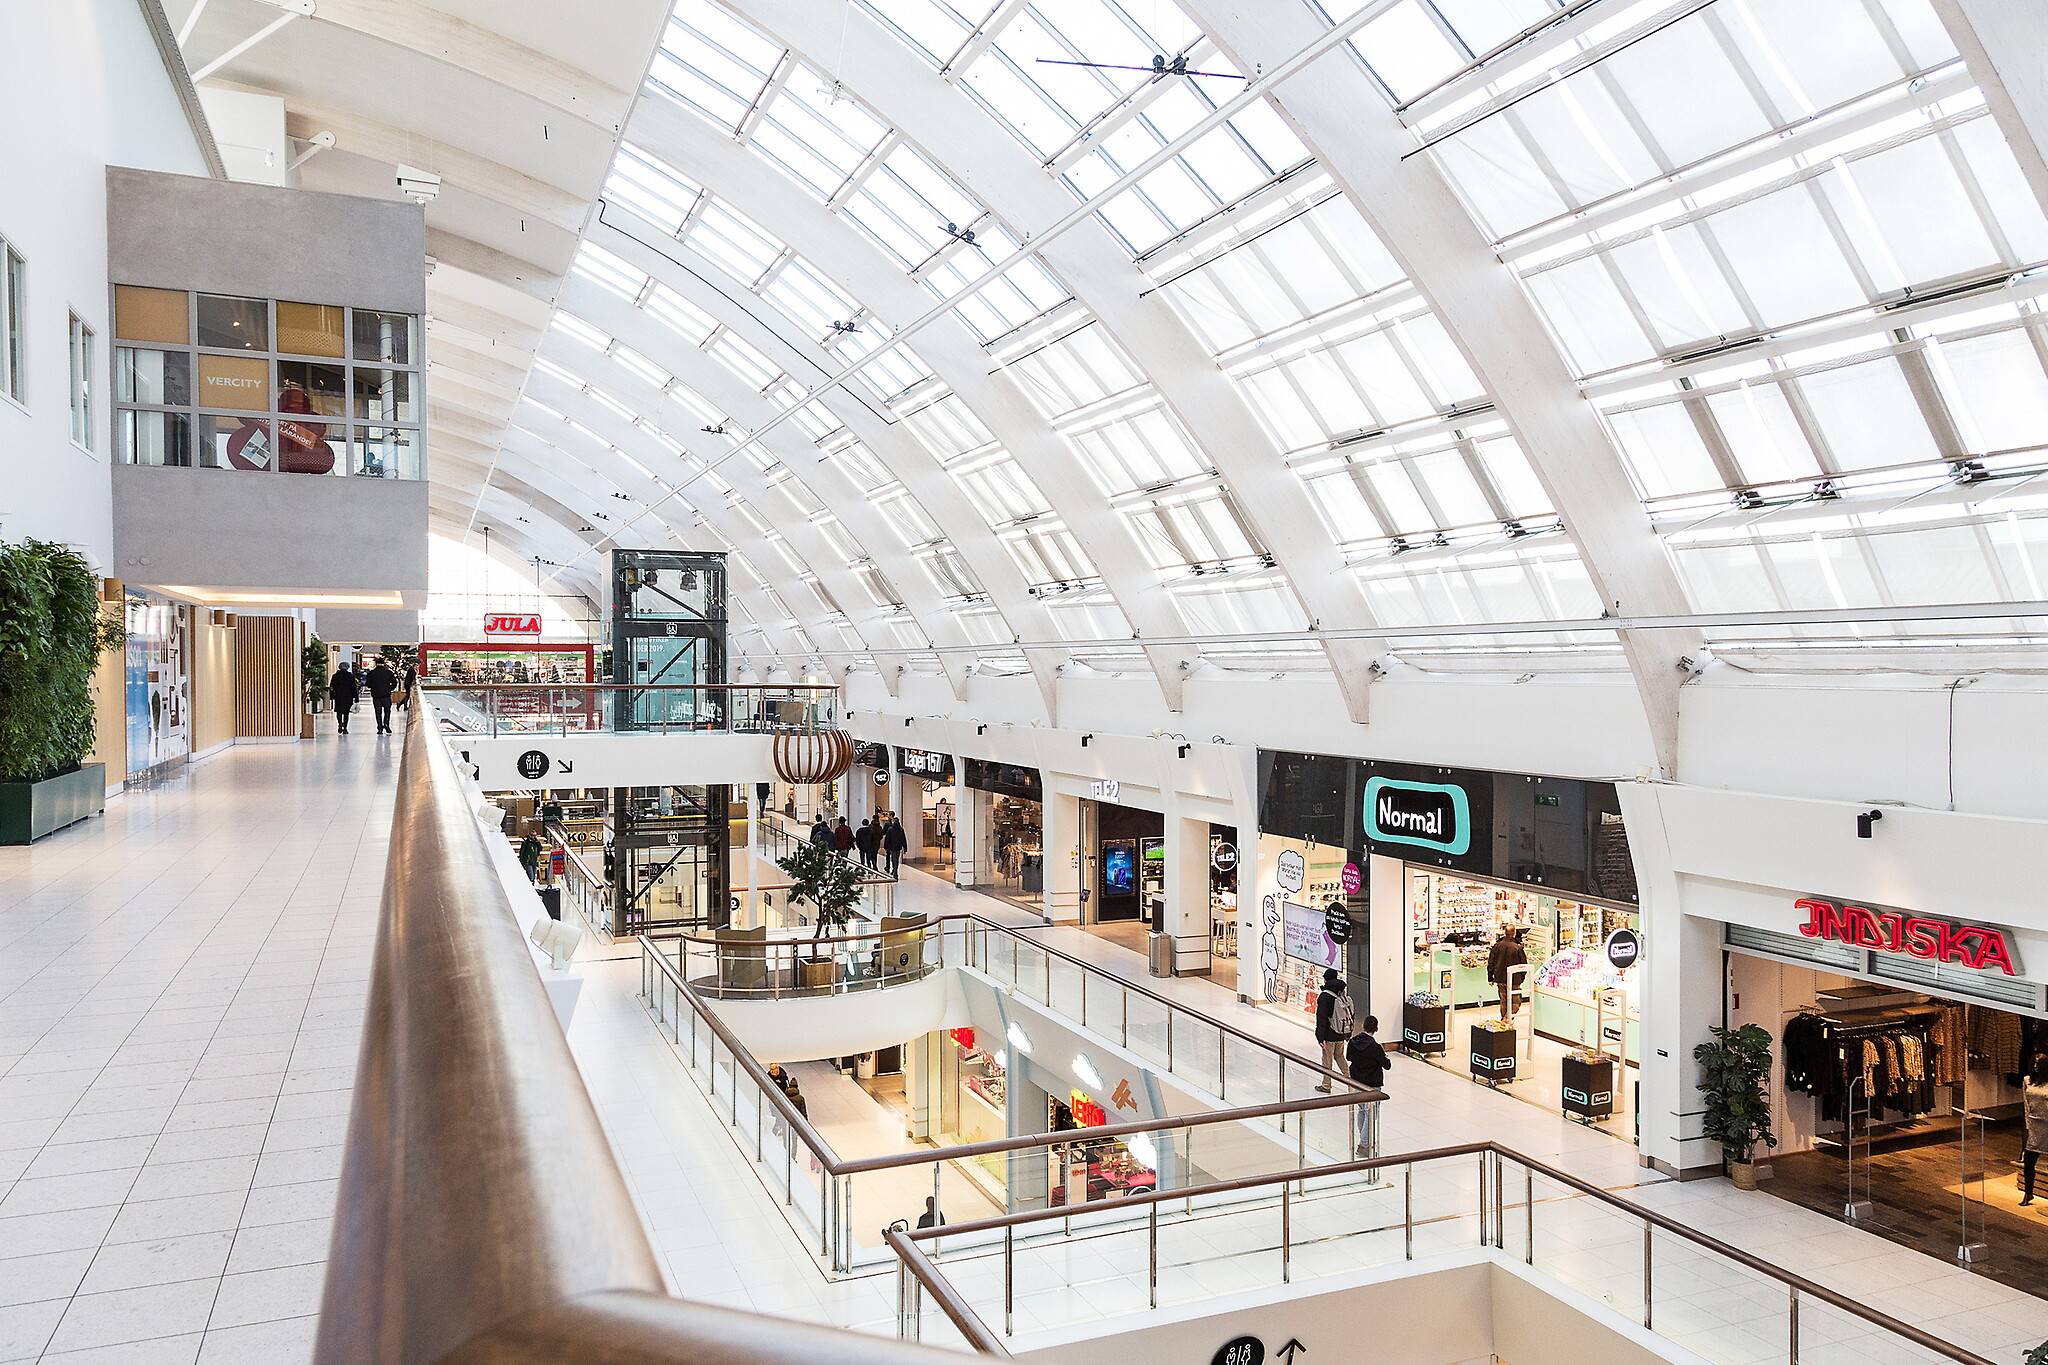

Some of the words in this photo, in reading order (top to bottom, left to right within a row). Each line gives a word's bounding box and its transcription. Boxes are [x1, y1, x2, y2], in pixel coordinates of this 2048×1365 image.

[207, 376, 262, 389] VERCITY
[486, 617, 540, 632] JULA
[904, 748, 926, 773] Lager
[1090, 780, 1120, 803] TELE2
[1379, 796, 1442, 835] Normal
[1794, 898, 2016, 976] INDISKA
